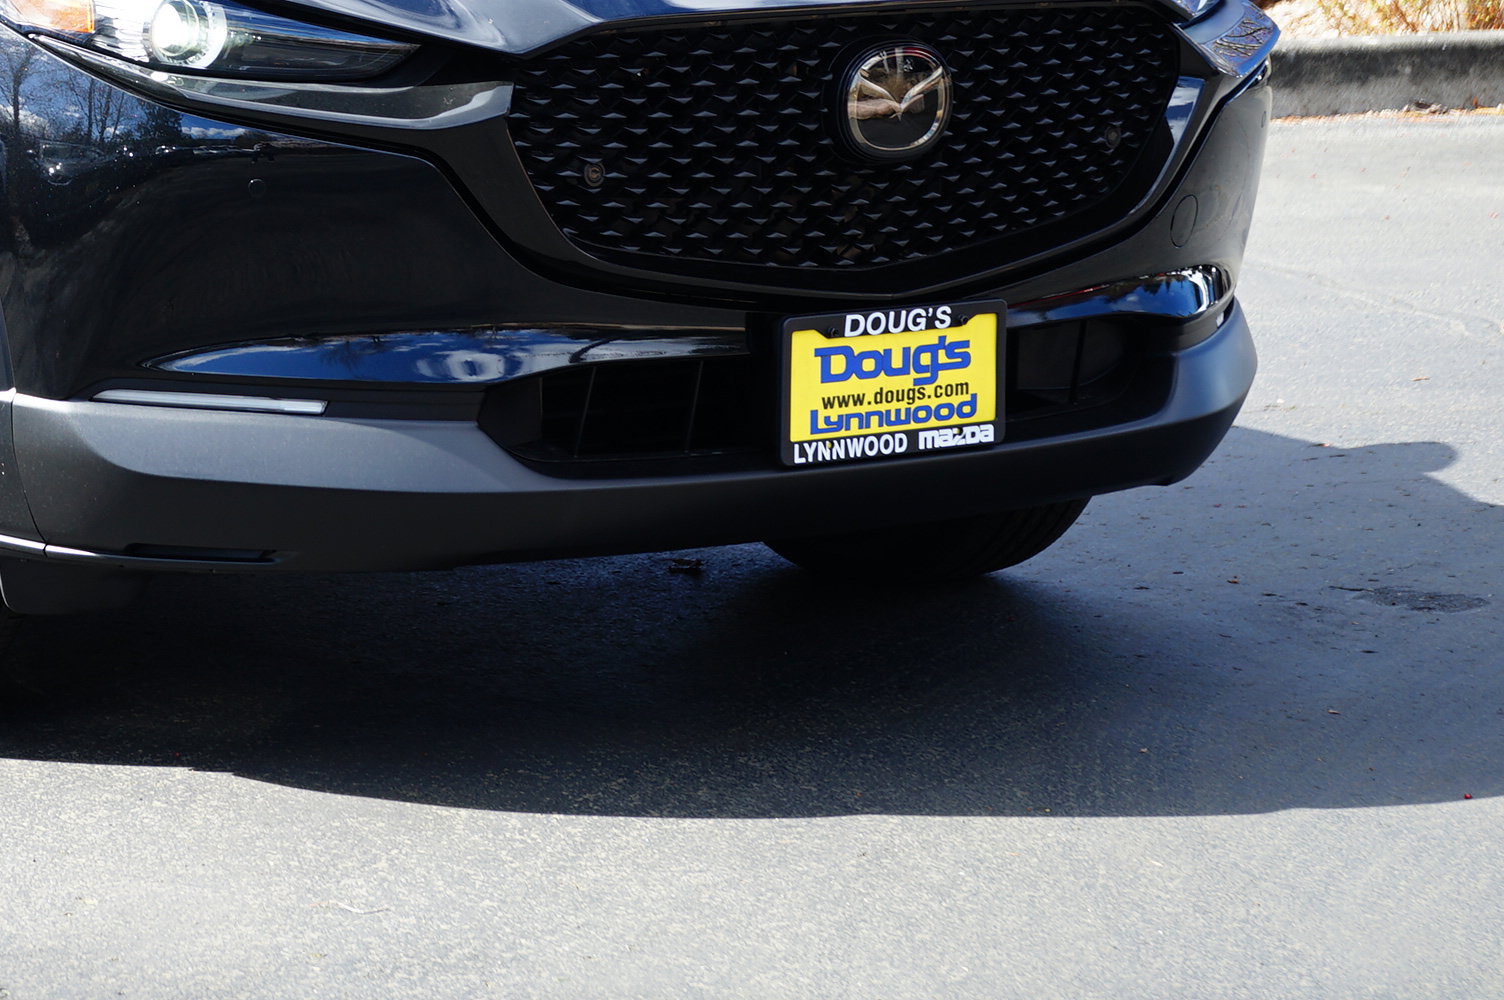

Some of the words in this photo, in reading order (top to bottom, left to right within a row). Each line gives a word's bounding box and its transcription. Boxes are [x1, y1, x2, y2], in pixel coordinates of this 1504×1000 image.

[844, 305, 952, 338] DOUG'S
[821, 382, 970, 410] www.dougs.com
[809, 393, 978, 435] Lynnwood
[793, 432, 908, 464] LYNNWOOD
